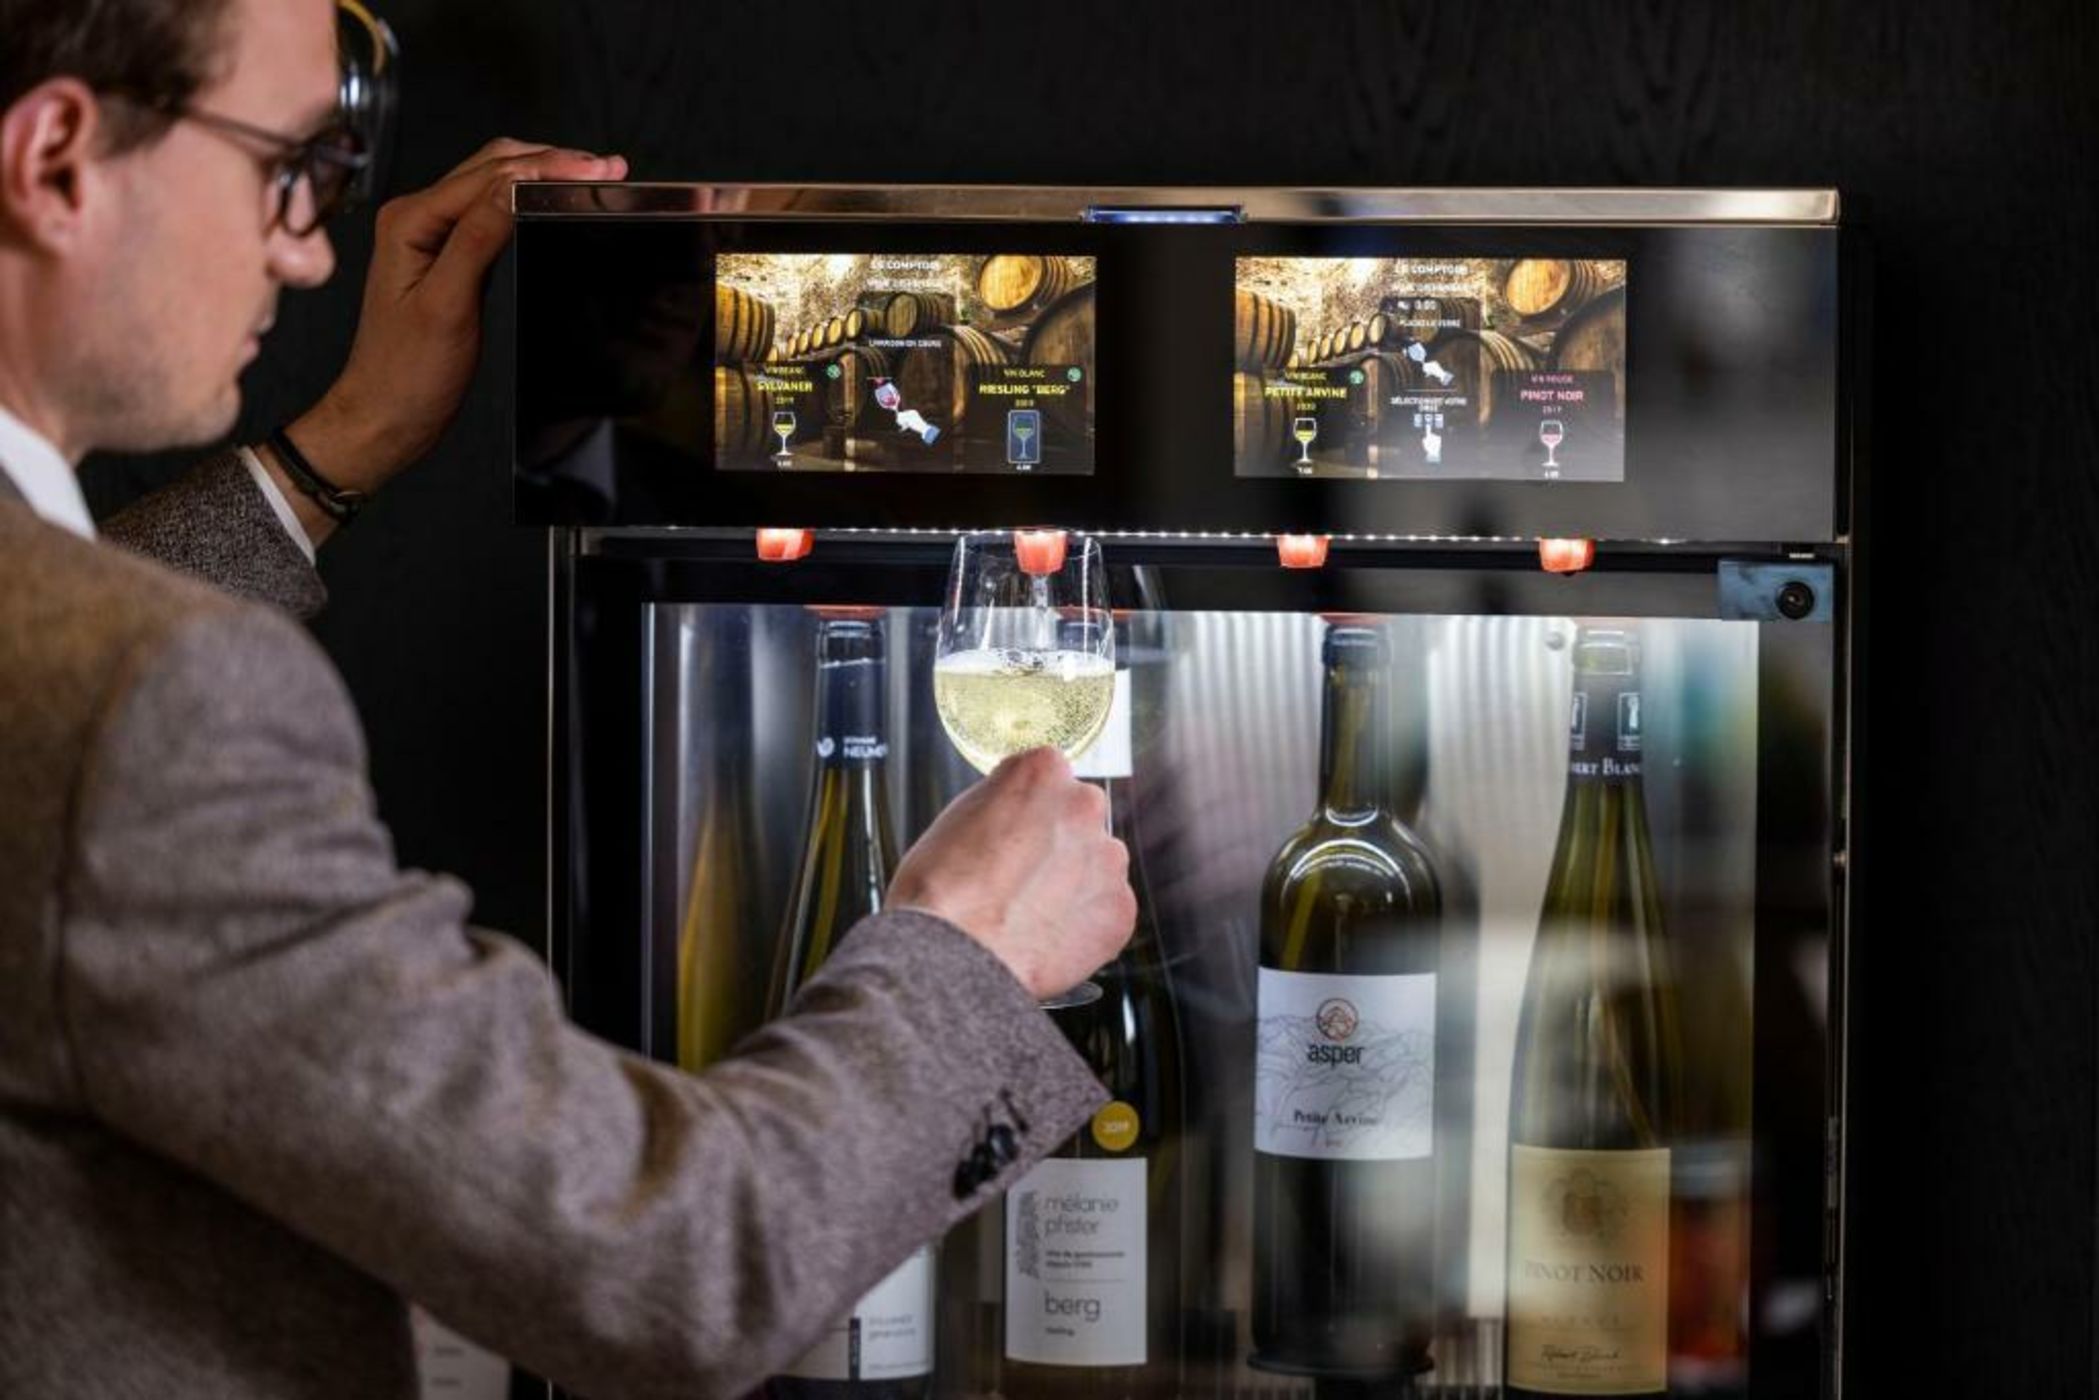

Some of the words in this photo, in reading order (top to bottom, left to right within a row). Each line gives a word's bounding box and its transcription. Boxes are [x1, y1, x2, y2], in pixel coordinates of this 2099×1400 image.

[757, 381, 813, 392] SYLVANER
[979, 384, 1030, 395] RIESLING
[1306, 386, 1347, 398] ARVINE
[1520, 389, 1554, 401] PINOT
[1556, 390, 1584, 401] NOIR
[1307, 1043, 1365, 1068] asper
[1587, 1263, 1646, 1284] NOIR
[1044, 1288, 1101, 1322] berg
